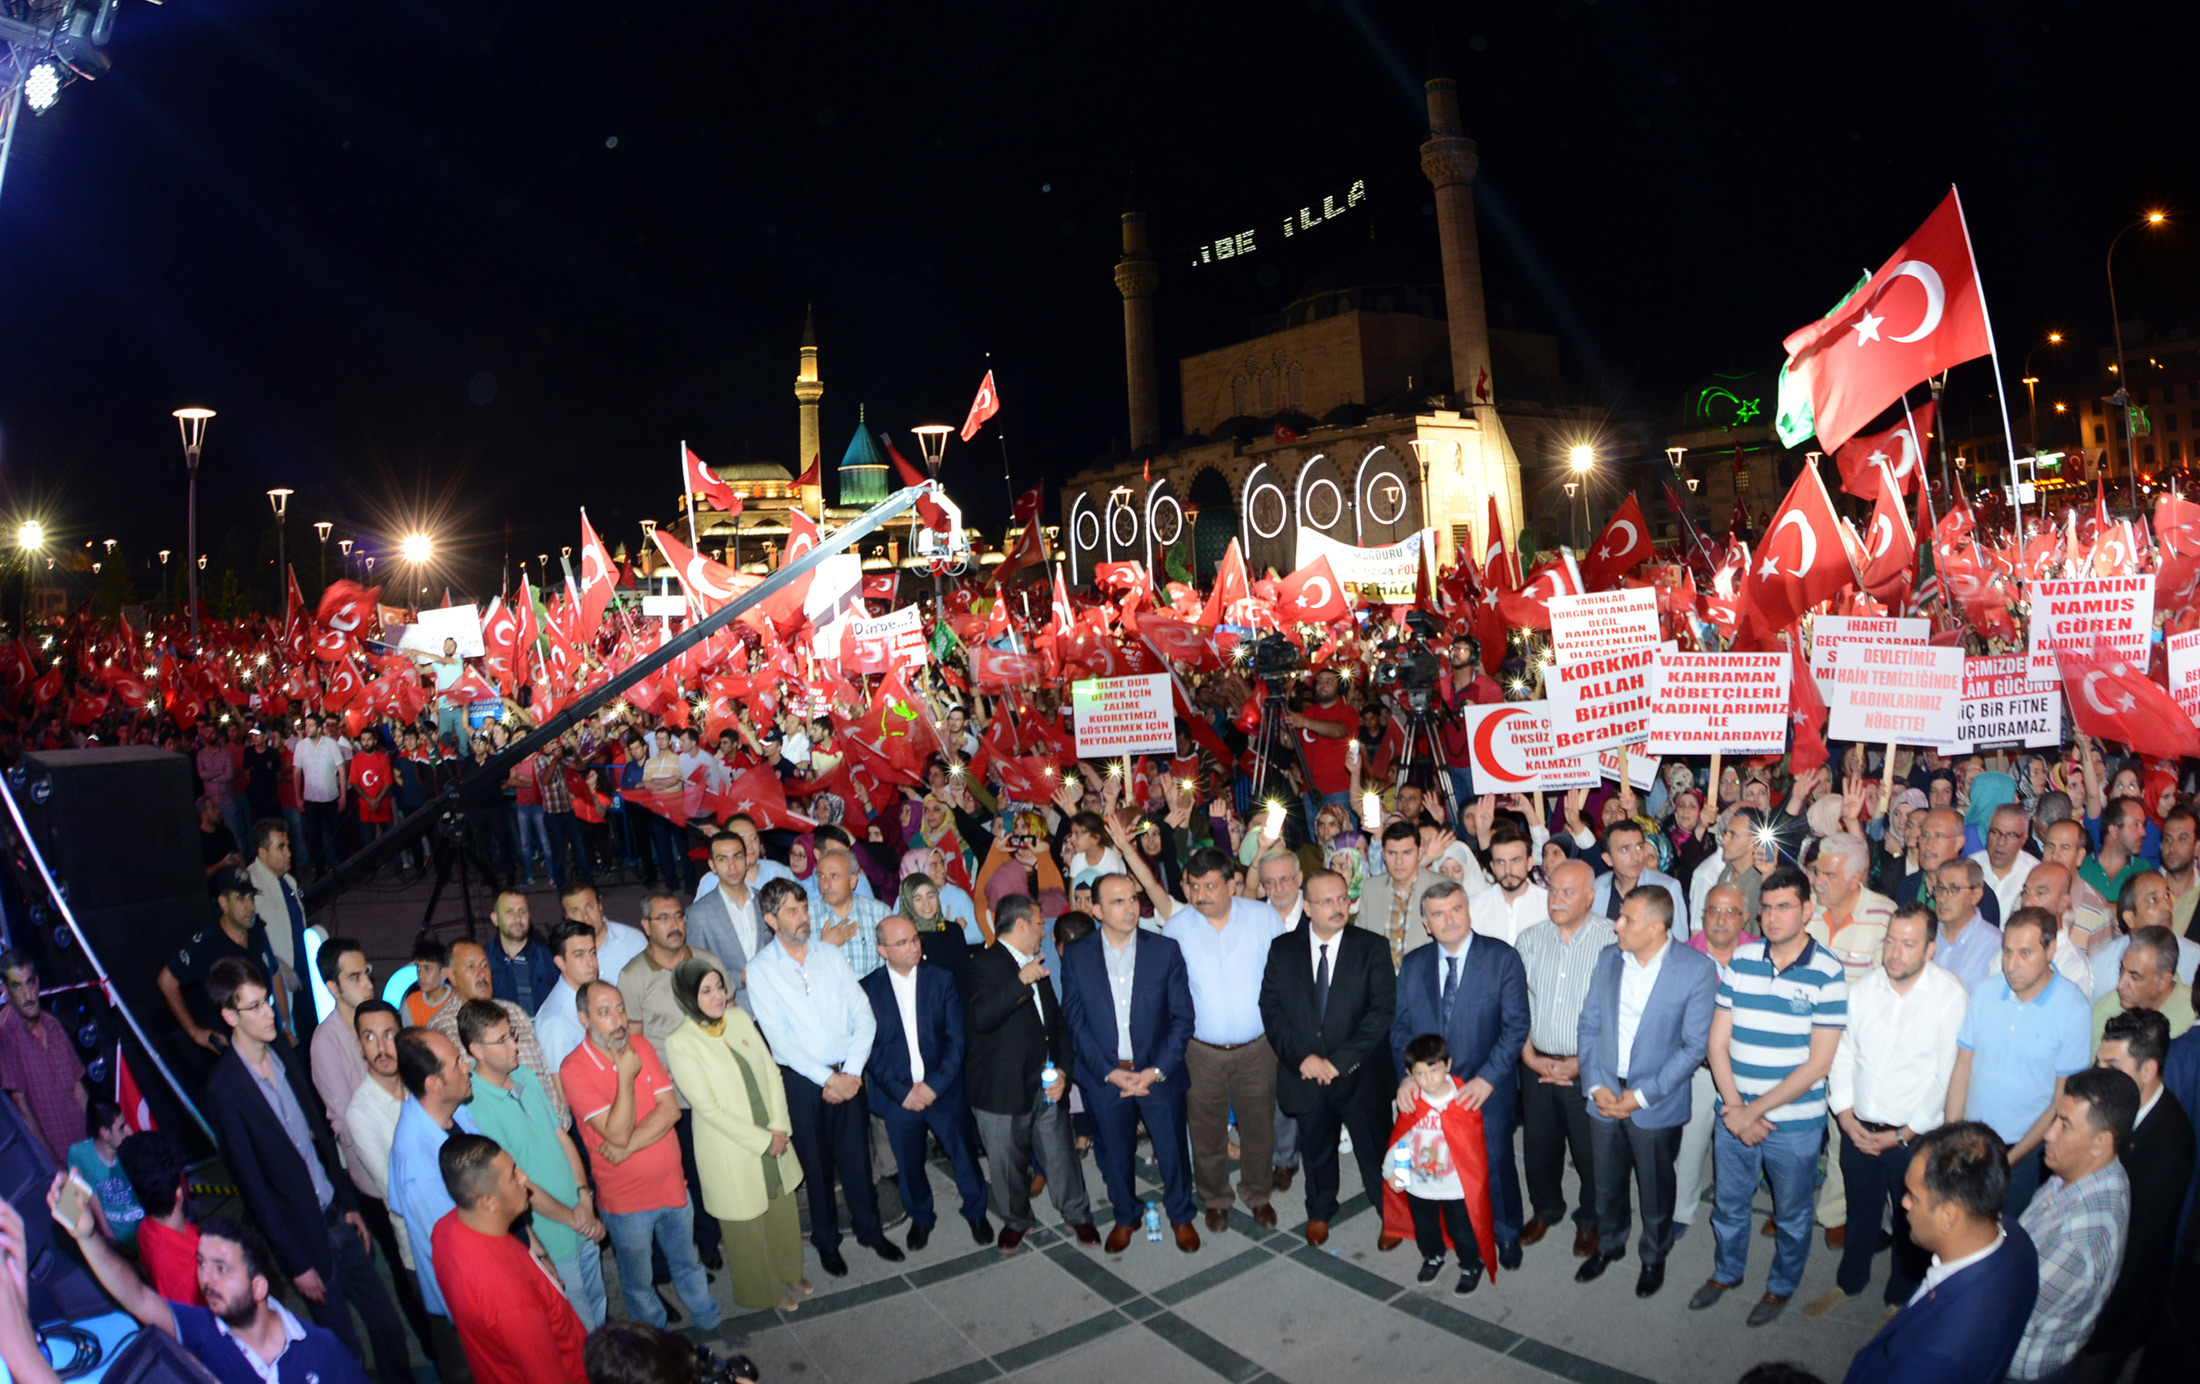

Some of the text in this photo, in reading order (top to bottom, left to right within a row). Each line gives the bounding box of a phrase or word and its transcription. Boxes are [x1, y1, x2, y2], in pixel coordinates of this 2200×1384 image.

[2040, 578, 2146, 596] VATANINI
[1575, 594, 1626, 606] YARINLAR
[2051, 598, 2135, 615] NAMUS
[1552, 602, 1655, 619] YORGUN OLANLARIN
[1565, 624, 1646, 638] RAHATINDAN
[2056, 617, 2132, 634] GÖREN
[1660, 656, 1781, 667] VATANIMIZIN
[1864, 648, 1937, 667] DEVLETİMİZ
[1096, 677, 1150, 690] ULME DUR
[1668, 672, 1776, 683] KAHRAMAN
[1837, 667, 1958, 690] HAİN TEMİZLİĞİNDE
[1580, 673, 1644, 701] ALLAH
[1660, 686, 1781, 701] NÖBETÇİLERİ
[1091, 688, 1152, 702] DEMEK İÇİN
[1850, 690, 1942, 711] KADINLARIMIZ
[1103, 700, 1141, 712] ZALİME
[1652, 703, 1789, 714] KADINLARIMIZ
[1089, 709, 1157, 724] KUDRETİMİZİ
[1708, 715, 1729, 727] İLE
[1864, 712, 1926, 732] NÖBETTE!
[1080, 720, 1169, 736] GÖSTERMEK İÇİN
[1506, 719, 1539, 731] TÜRK
[1080, 732, 1173, 747] MEYDANLARDAYIZ
[1511, 732, 1550, 745] ÖKSÜZ
[1650, 731, 1783, 741] MEYDANLARDAYIZ
[1523, 746, 1555, 757] YURT
